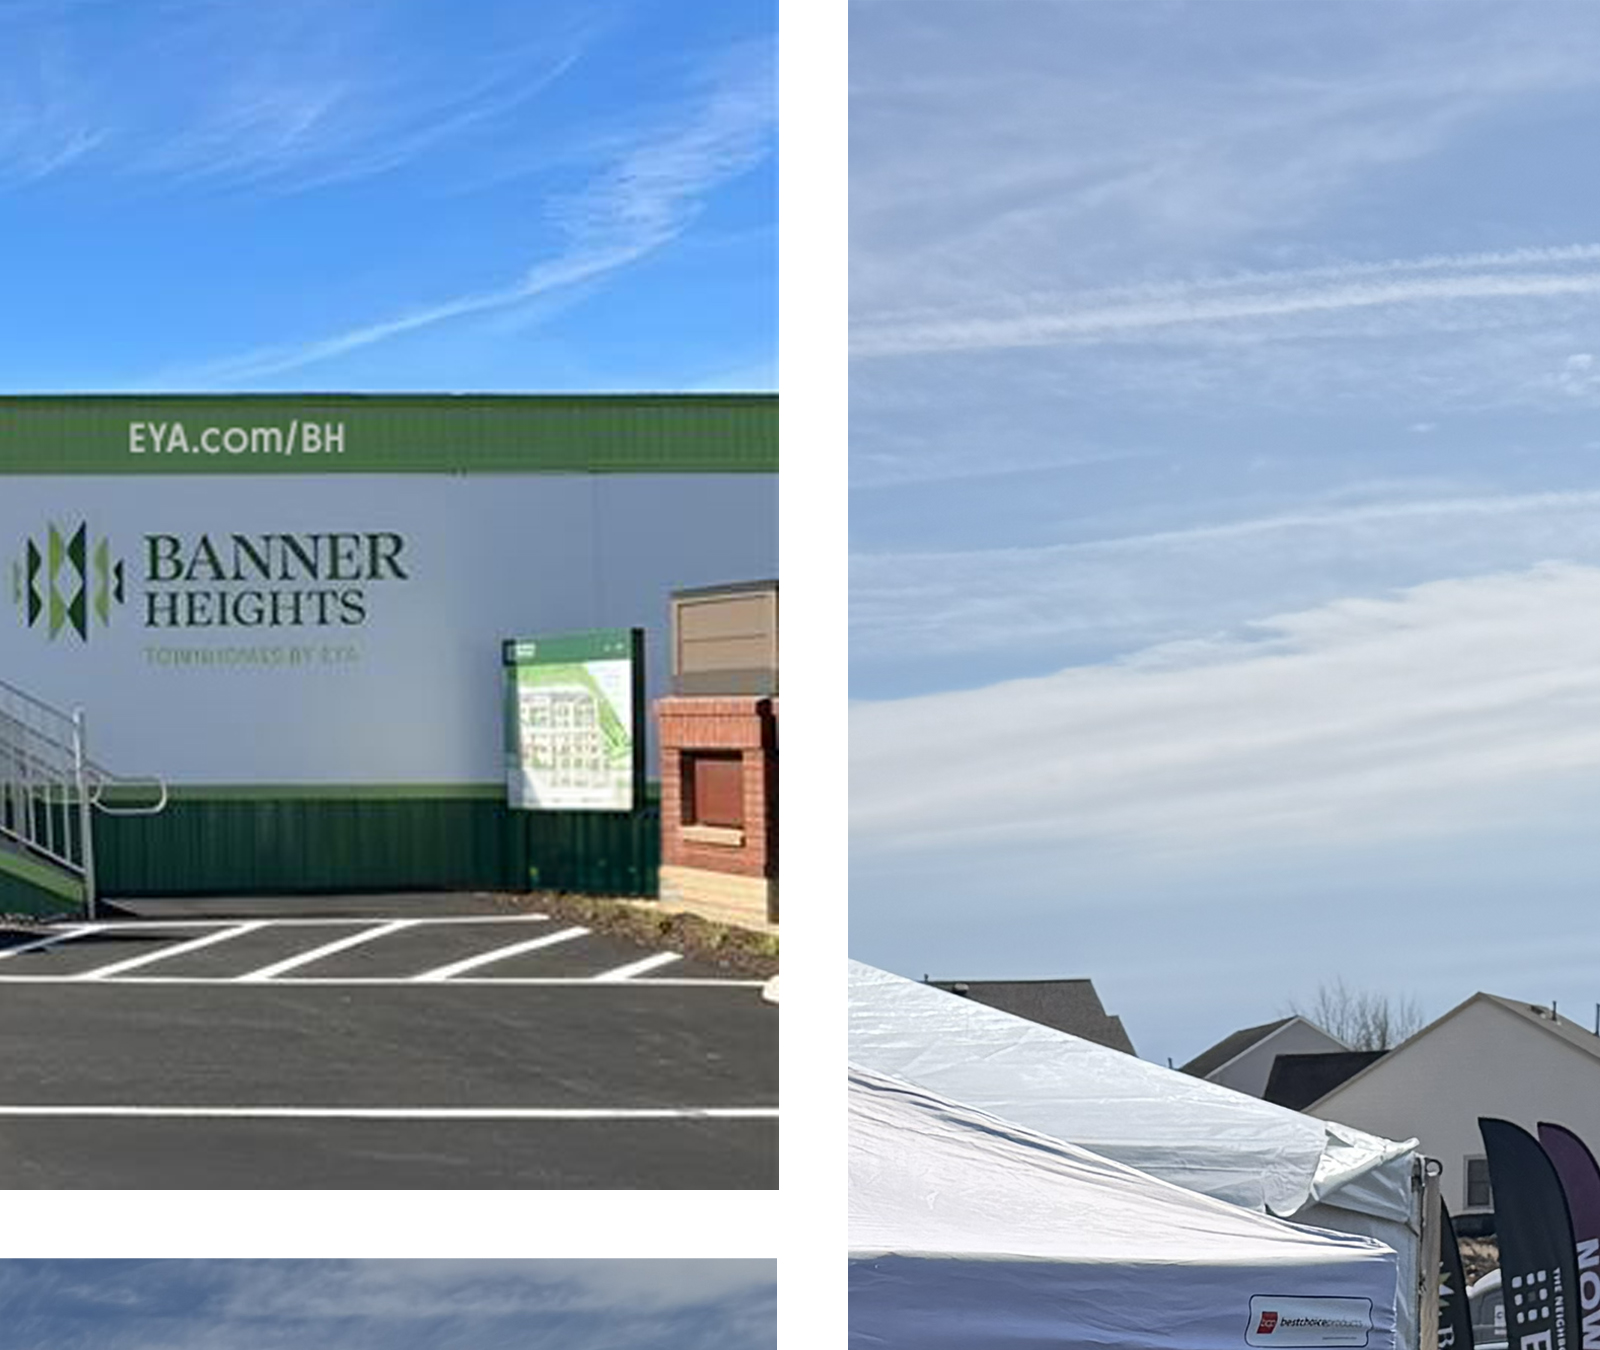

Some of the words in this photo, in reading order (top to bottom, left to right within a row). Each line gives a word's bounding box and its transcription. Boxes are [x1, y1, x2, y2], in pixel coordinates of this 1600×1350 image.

[129, 420, 345, 456] EYA.com/BH
[144, 532, 409, 581] BANNER
[144, 588, 366, 628] HEIGHTS
[1552, 1267, 1563, 1292] THE
